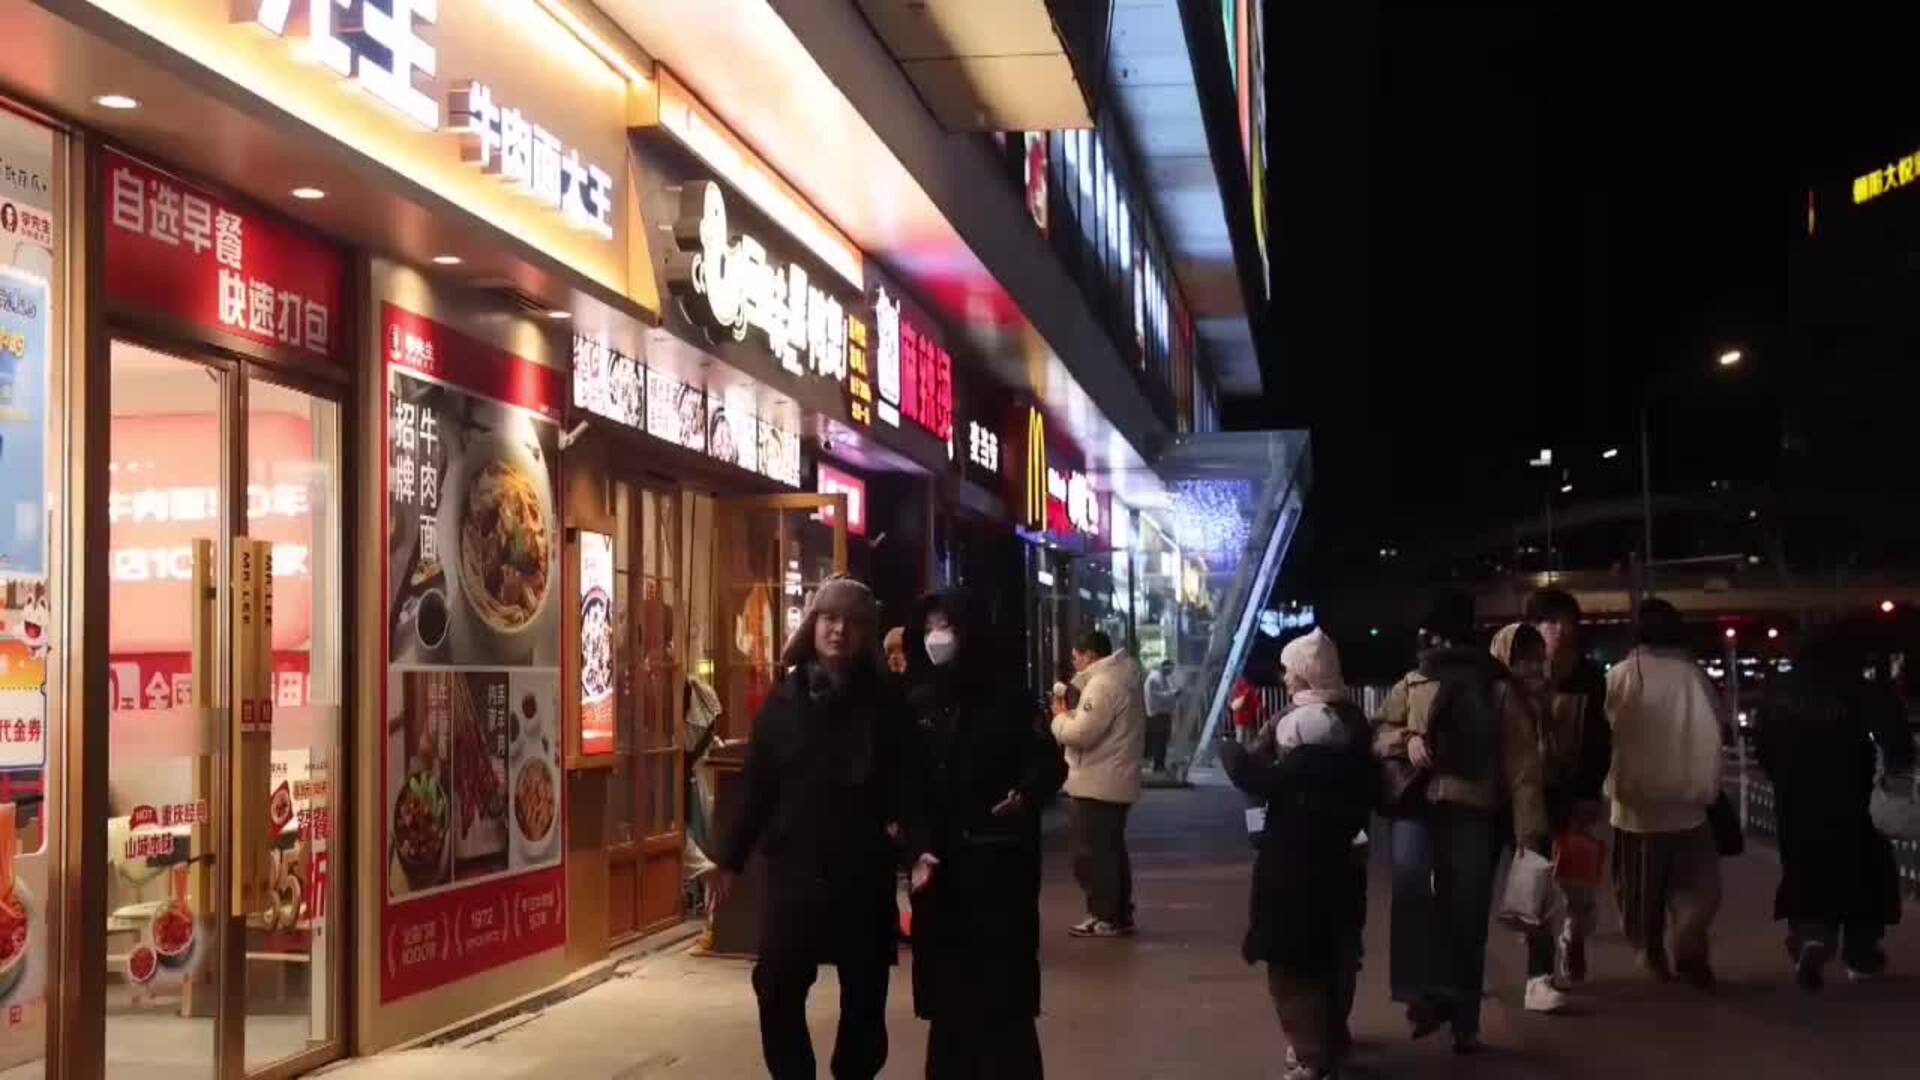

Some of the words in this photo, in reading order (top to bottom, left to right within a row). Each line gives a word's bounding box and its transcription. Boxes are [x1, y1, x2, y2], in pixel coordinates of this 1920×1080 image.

[469, 80, 612, 241] 牛肉面大王
[113, 168, 241, 272] 自选早餐
[218, 268, 326, 356] 快速打包
[395, 399, 415, 505] 招牌
[419, 408, 438, 561] 牛肉面
